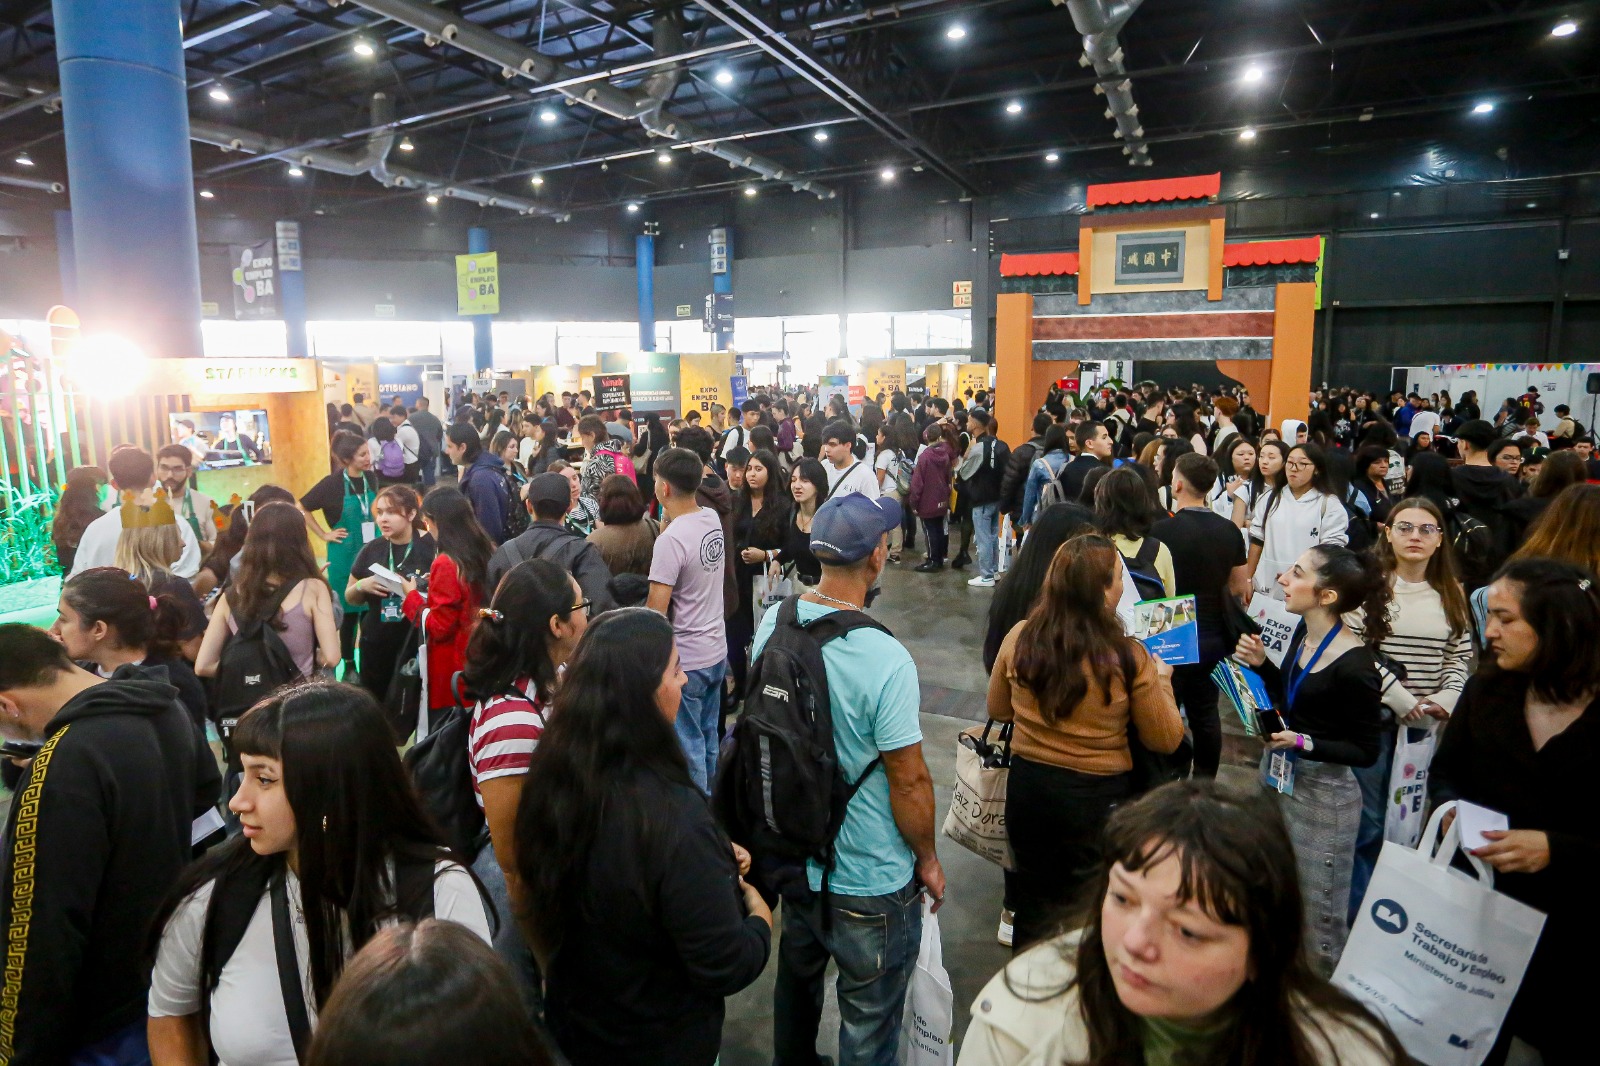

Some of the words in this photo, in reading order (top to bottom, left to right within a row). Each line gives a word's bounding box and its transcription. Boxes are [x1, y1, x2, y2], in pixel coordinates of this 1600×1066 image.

[253, 257, 273, 268] EXPO
[478, 266, 495, 274] EXPO
[245, 269, 273, 280] EMPLEO
[256, 279, 274, 296] BA
[479, 283, 495, 295] BA
[1262, 625, 1288, 640] PLEO
[1266, 618, 1292, 633] EXPO
[1261, 634, 1282, 652] BA
[972, 801, 1006, 826] Dora
[1407, 932, 1459, 967] Trabajo
[1459, 962, 1469, 973] y
[1469, 965, 1506, 985] Empleo
[1404, 950, 1454, 985] Ministerio
[1455, 981, 1468, 991] de
